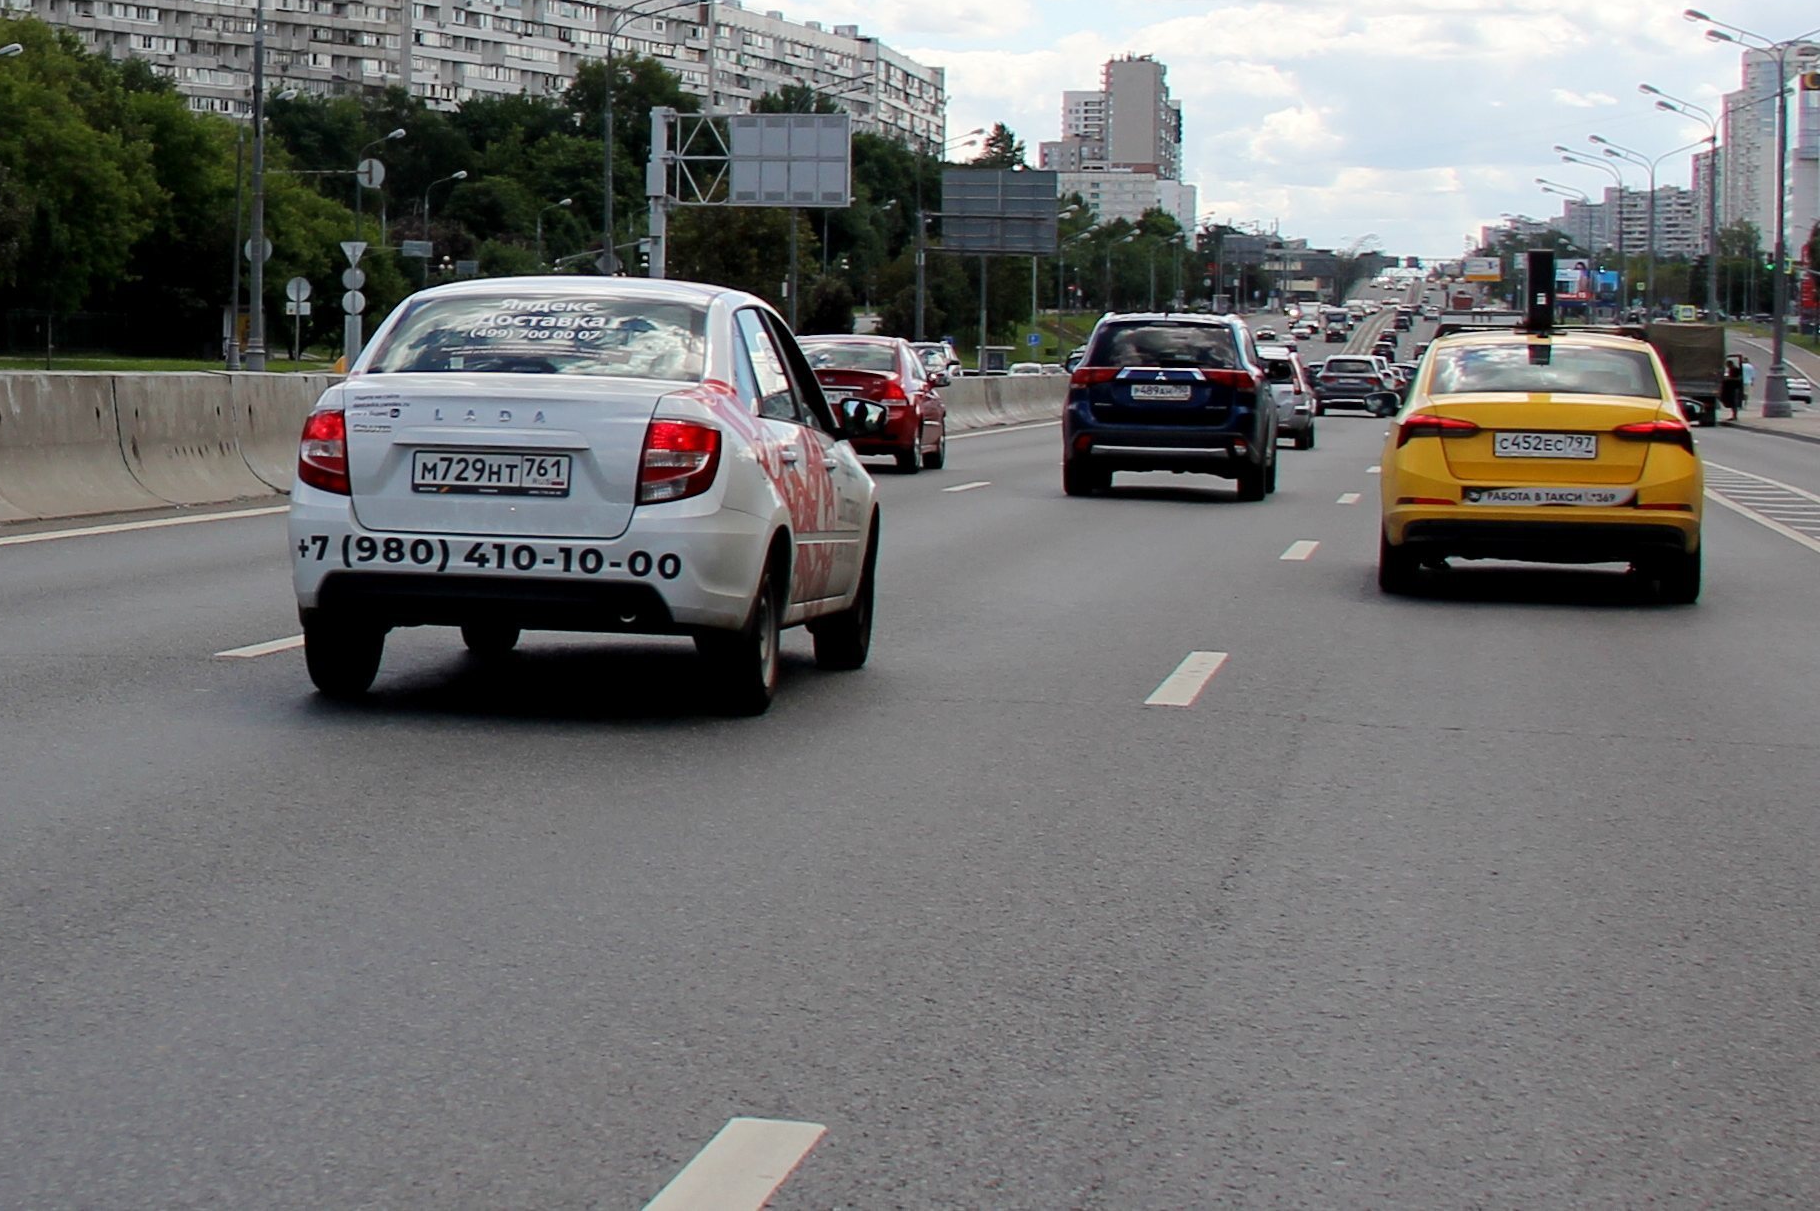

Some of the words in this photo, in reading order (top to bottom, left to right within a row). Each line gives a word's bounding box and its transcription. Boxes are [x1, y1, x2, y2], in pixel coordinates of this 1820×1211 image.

[500, 298, 599, 312] Яндекс
[477, 313, 607, 328] Доставка
[470, 328, 514, 340] (499)
[519, 329, 550, 340] 700
[552, 329, 576, 340] 00
[578, 329, 601, 340] 07
[434, 408, 546, 423] LADA
[1499, 434, 1564, 452] С452ЕС
[1566, 435, 1593, 448] 797
[420, 457, 519, 483] М729НТ
[524, 458, 561, 478] 761
[1487, 492, 1531, 502] РАБОТА
[1535, 492, 1542, 502] В
[1545, 492, 1582, 502] ТАКСИ
[298, 535, 330, 561] +7
[341, 535, 451, 573] (980)
[464, 542, 682, 580] 410-10-00
